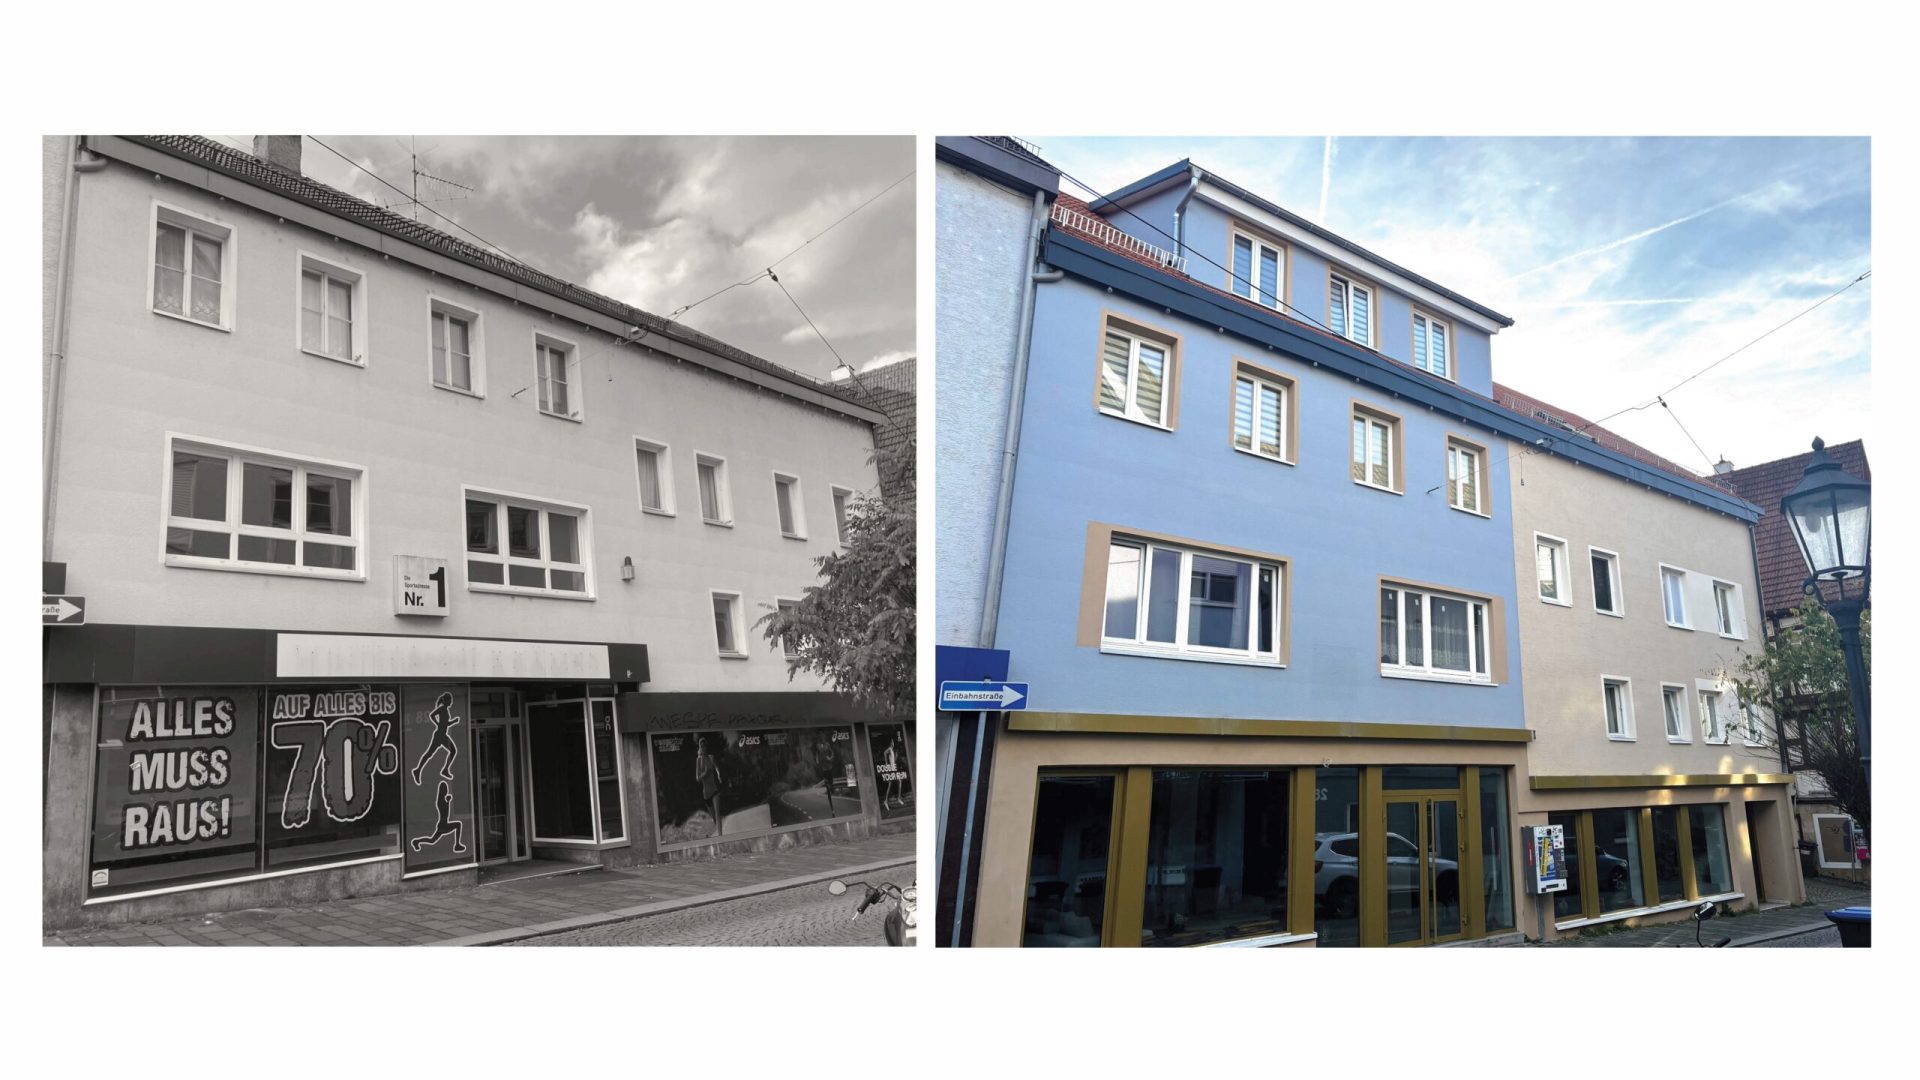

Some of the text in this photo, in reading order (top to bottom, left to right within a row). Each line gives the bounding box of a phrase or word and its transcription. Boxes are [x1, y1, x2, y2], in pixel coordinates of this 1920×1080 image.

[404, 566, 446, 607] Nr. 1
[273, 692, 396, 719] AUF ALLES BIS
[946, 692, 1004, 700] Einbahnstraße
[129, 699, 233, 739] ALLES
[131, 749, 228, 791] MUSS
[272, 717, 398, 829] 70%
[124, 798, 230, 847] RAUS!
